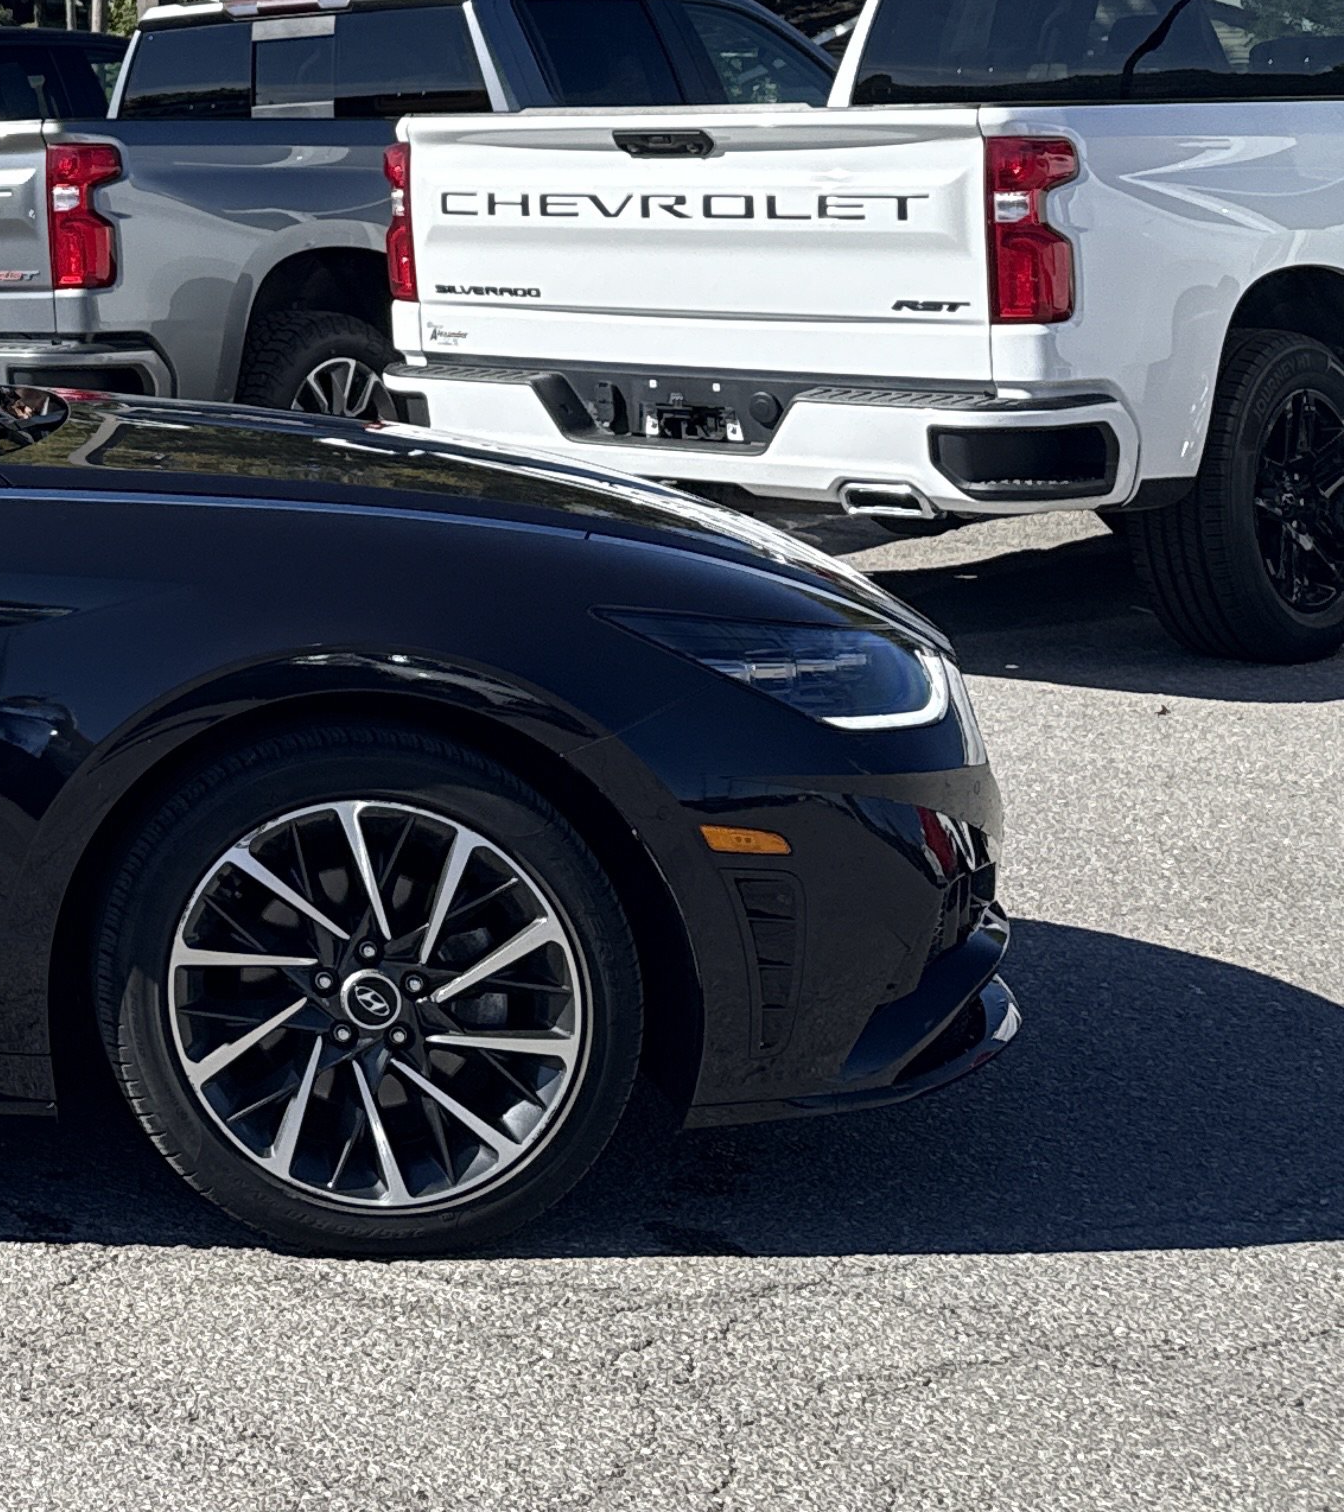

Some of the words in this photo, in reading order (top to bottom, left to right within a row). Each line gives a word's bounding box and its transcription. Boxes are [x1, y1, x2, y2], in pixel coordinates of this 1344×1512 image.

[440, 192, 929, 221] CHEVROLET
[435, 284, 541, 298] SILVERADO
[891, 299, 971, 313] RST
